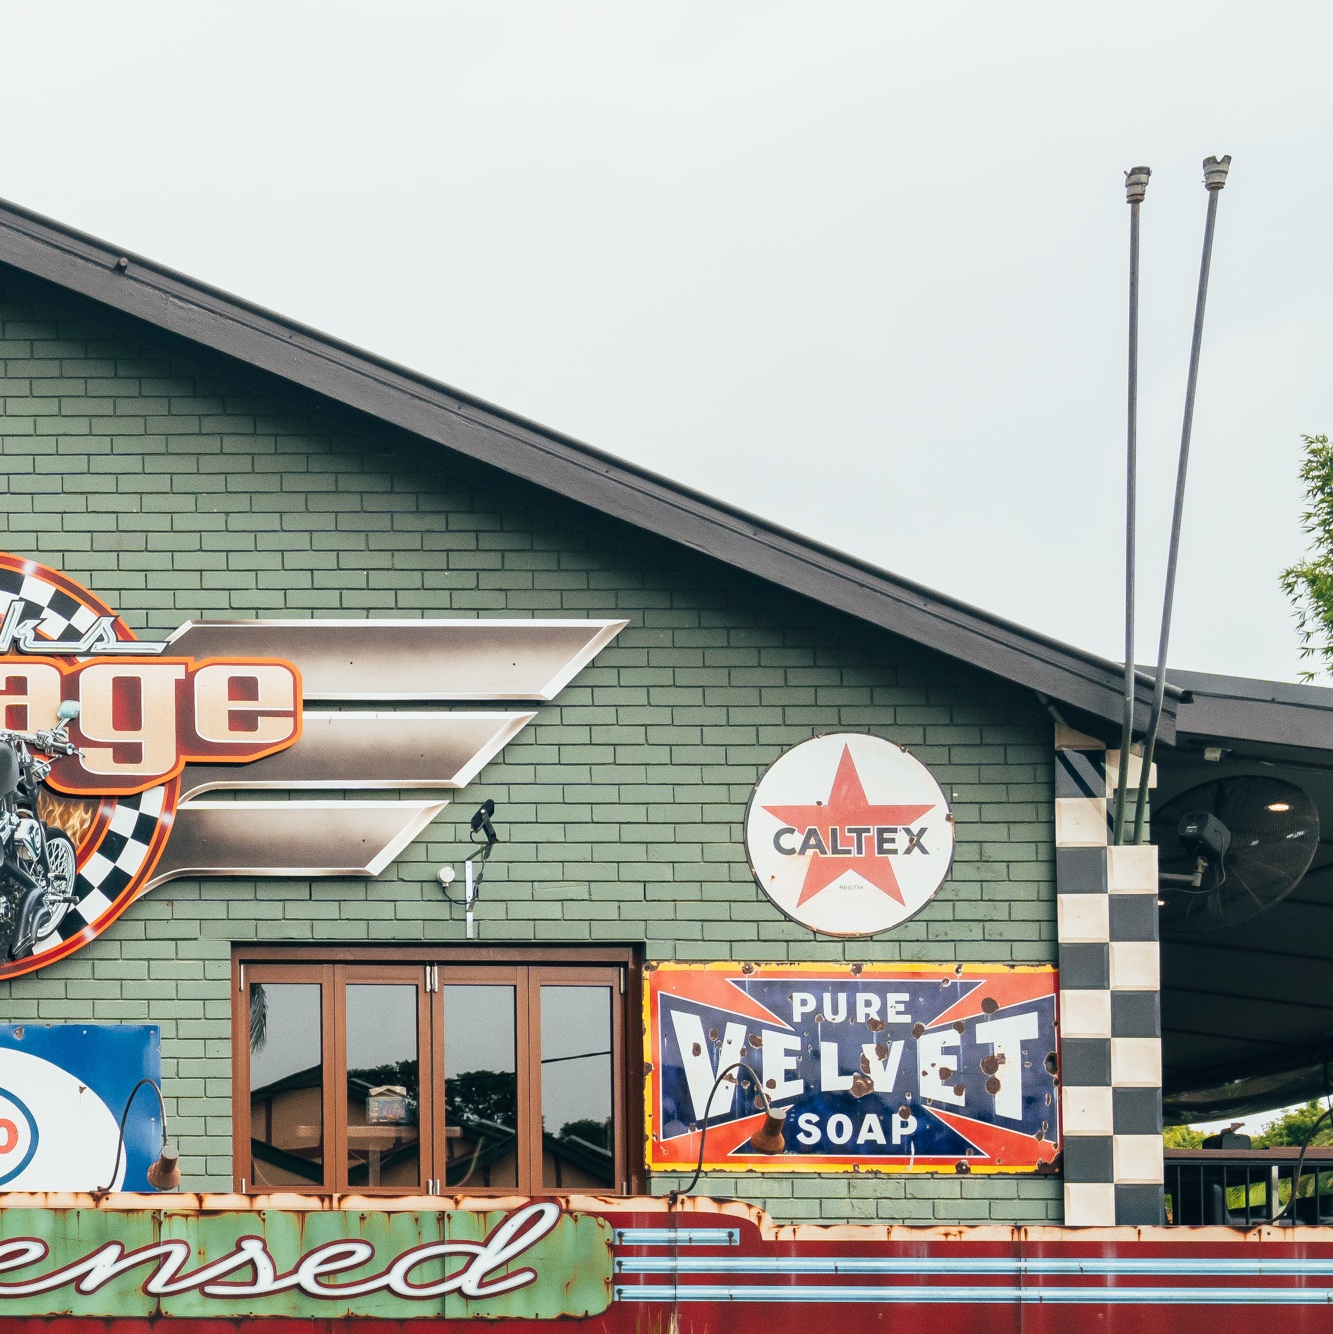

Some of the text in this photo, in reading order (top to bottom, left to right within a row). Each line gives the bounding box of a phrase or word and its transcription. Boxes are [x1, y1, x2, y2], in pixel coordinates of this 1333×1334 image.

[773, 827, 930, 856] CALTEX
[792, 993, 912, 1024] PURE
[670, 1009, 1039, 1122] VELVET
[796, 1113, 918, 1146] SOAP
